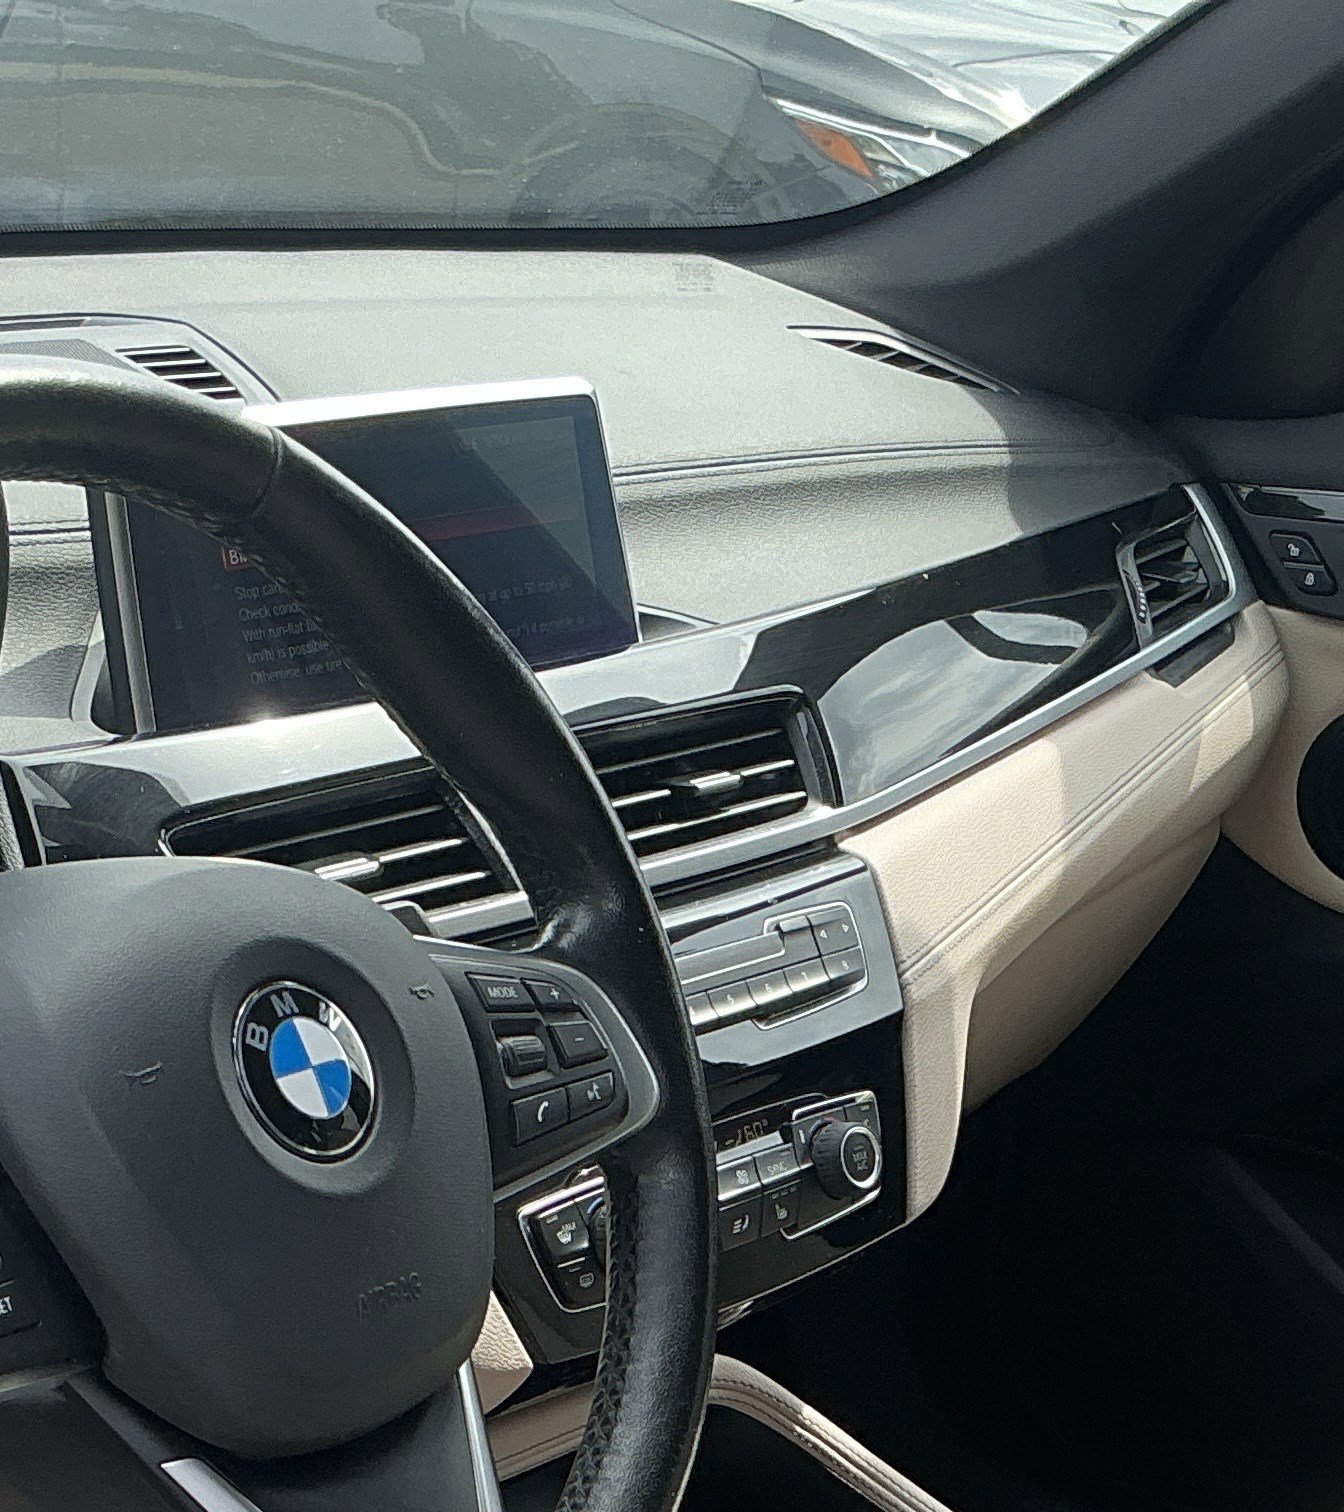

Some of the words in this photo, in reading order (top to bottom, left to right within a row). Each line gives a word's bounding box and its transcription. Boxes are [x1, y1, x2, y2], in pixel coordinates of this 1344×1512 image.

[238, 604, 271, 622] Check
[487, 985, 519, 999] MODE
[245, 989, 342, 1052] BMW
